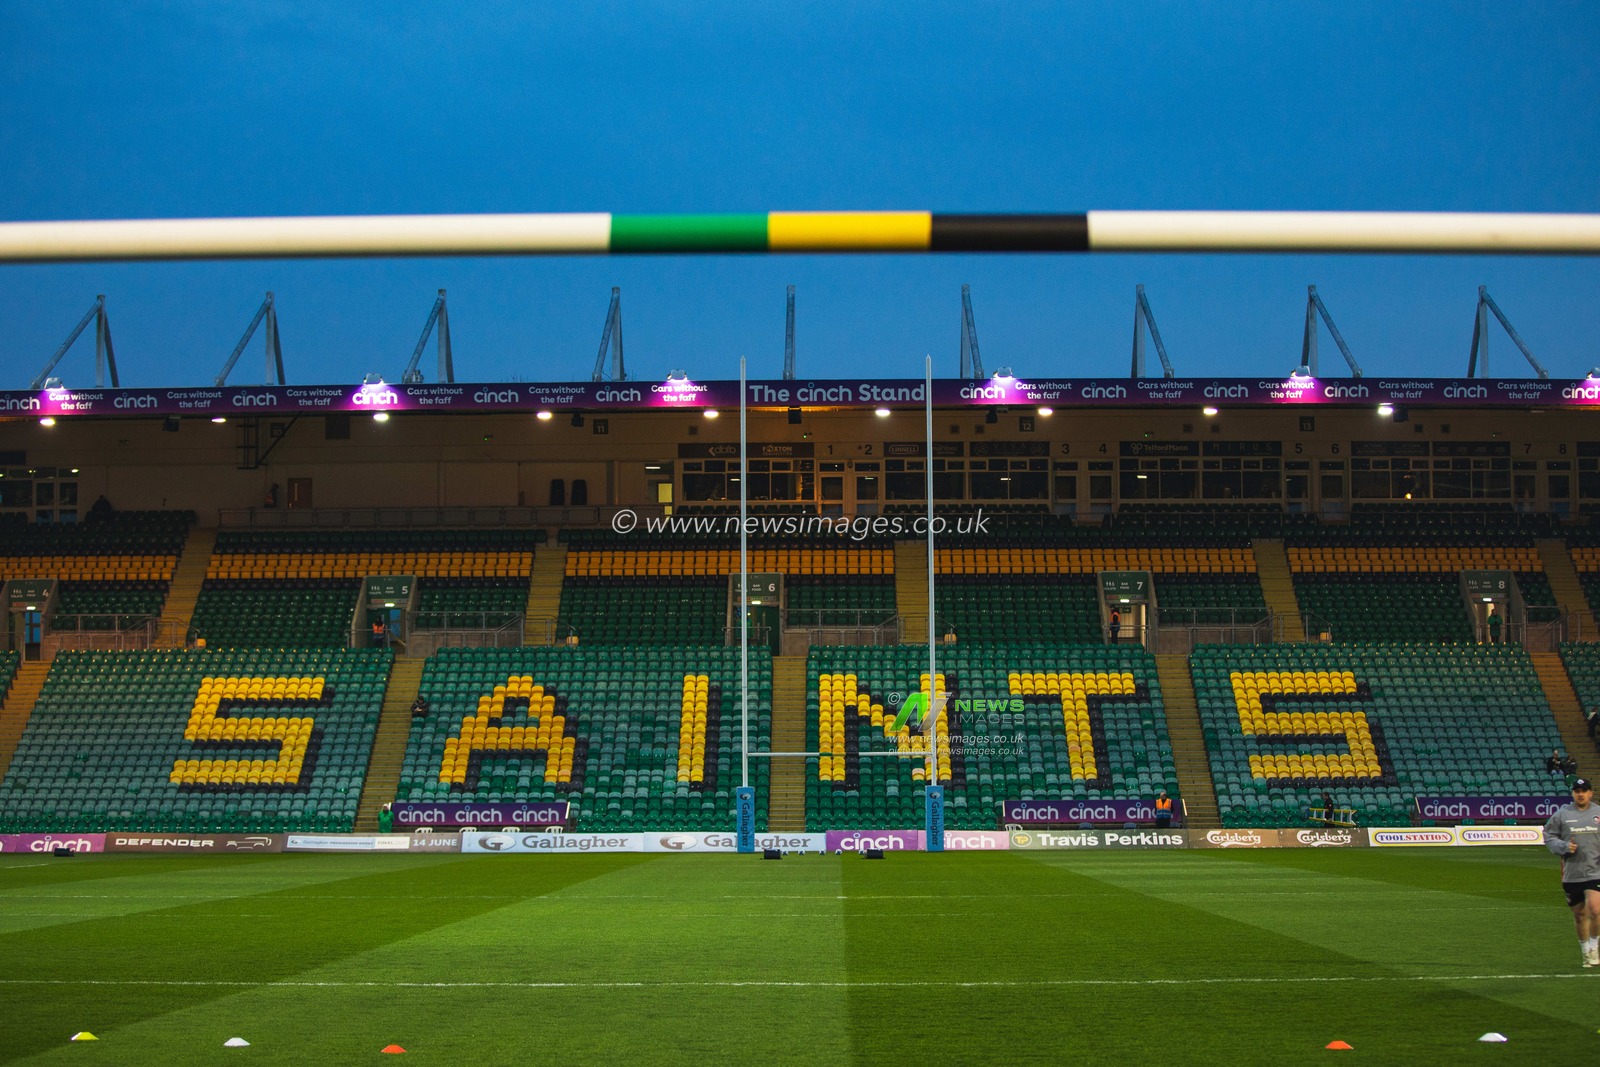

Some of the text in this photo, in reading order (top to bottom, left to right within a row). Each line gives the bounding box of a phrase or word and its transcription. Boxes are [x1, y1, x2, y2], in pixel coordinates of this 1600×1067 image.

[551, 386, 585, 394] without
[651, 384, 708, 393] Cars without
[960, 382, 1005, 399] cinch
[1081, 382, 1127, 398] cinch
[1137, 381, 1193, 389] Cars without
[1204, 381, 1248, 398] cinch
[1258, 381, 1315, 389] Cars without
[1324, 381, 1369, 398] cinch
[1378, 381, 1434, 389] Cars without
[1443, 381, 1487, 398] cinch
[1497, 382, 1518, 390] Cars
[49, 392, 104, 401] Cars without
[352, 388, 398, 405] cinch
[474, 386, 519, 403] cinch
[596, 385, 641, 401] cinch
[749, 382, 925, 402] The cinch Stand
[113, 392, 157, 408] cinch
[232, 390, 277, 406] cinch
[663, 394, 677, 402] the
[60, 402, 93, 410] the faff
[179, 400, 193, 408] the
[1023, 423, 1031, 431] 12
[762, 444, 792, 452] FOXTON
[827, 444, 833, 455] 1
[864, 444, 872, 455] 2
[1062, 443, 1070, 454] 3
[1099, 443, 1107, 454] 4
[1295, 443, 1303, 454] 5
[1331, 443, 1339, 454] 6
[1524, 444, 1532, 454] 7
[1559, 444, 1567, 454] 8
[401, 586, 408, 595] 5
[768, 583, 776, 592] 6
[1137, 582, 1143, 590] 7
[1498, 581, 1505, 590] 8
[170, 671, 1381, 785] SAINTS
[455, 804, 502, 822] cinch
[512, 804, 559, 822] cinch
[1012, 802, 1059, 820] cinch
[1069, 802, 1116, 819] cinch
[1424, 799, 1470, 817] cinch
[1480, 799, 1525, 816] cinch
[398, 805, 446, 822] cinch
[740, 803, 750, 848] Gallagher
[930, 802, 940, 847] Gallagher
[840, 833, 904, 850] cinch
[1036, 832, 1183, 846] Travis Perkins
[1206, 830, 1262, 847] Carlsberg
[1297, 829, 1352, 847] Carlsberg
[1378, 834, 1449, 842] TOOLSTATION
[1466, 832, 1535, 840] TOOLSTATION
[30, 836, 92, 852] cinch
[115, 838, 214, 847] DEFENDER
[413, 838, 426, 847] 14
[429, 838, 457, 847] JUNE
[522, 835, 628, 850] Gallagher
